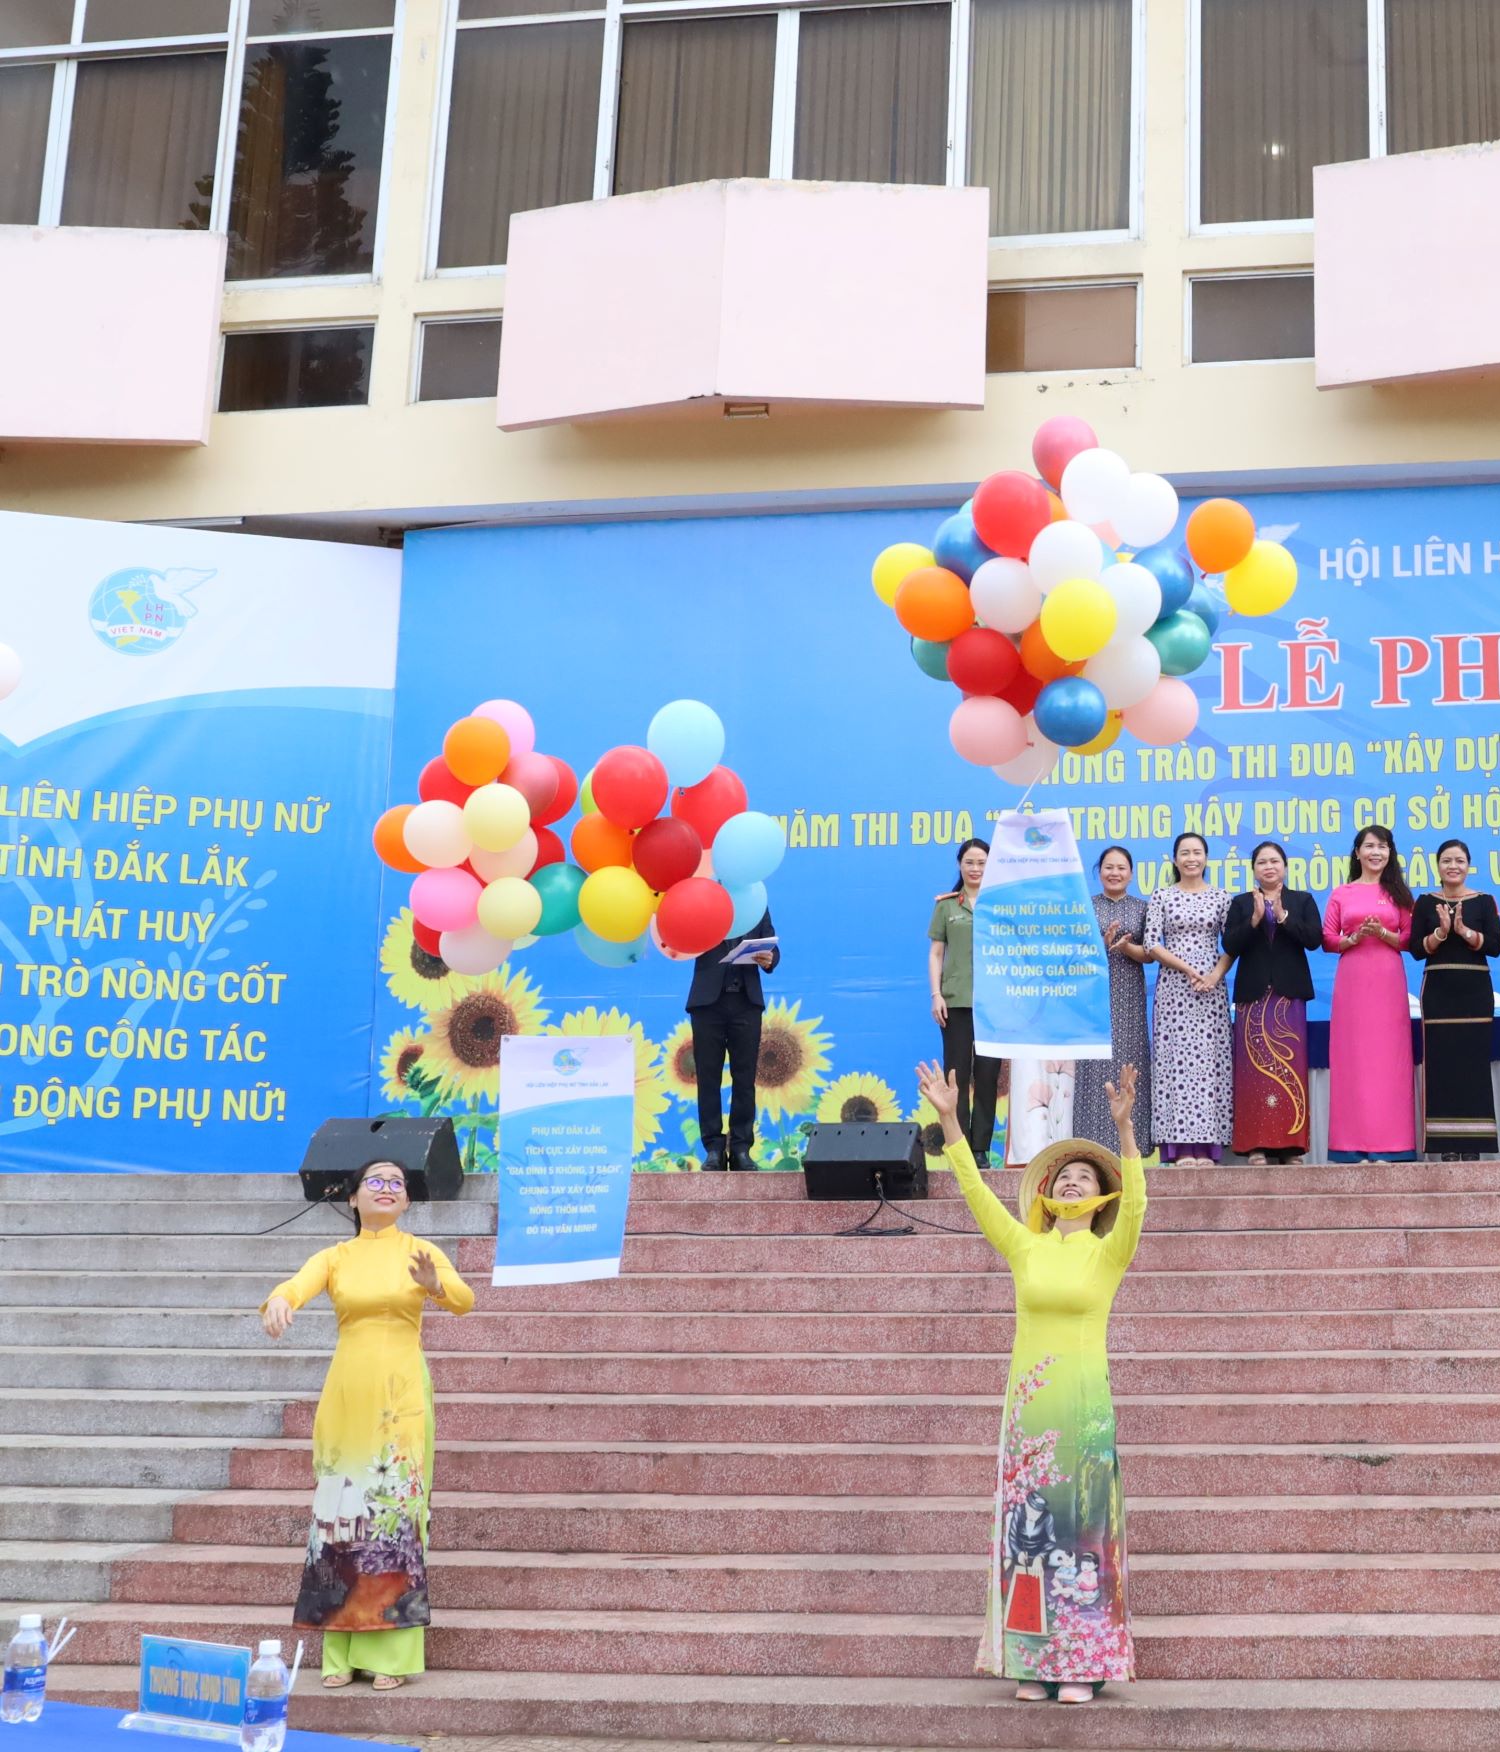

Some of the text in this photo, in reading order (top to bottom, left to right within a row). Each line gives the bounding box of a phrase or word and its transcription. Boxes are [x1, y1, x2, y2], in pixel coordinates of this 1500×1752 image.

[1320, 538, 1380, 587] HỘI
[1393, 535, 1471, 577] LIÊN
[139, 626, 163, 638] NAM
[1212, 617, 1345, 714] LỄ
[1136, 740, 1216, 782] TRÀO
[1227, 744, 1278, 779] THI
[1289, 741, 1355, 777] ĐUA
[1366, 732, 1444, 775] “XÂY
[0, 779, 331, 837] LIÊN HIỆP PHỤ NỮ
[851, 811, 898, 846] THI
[910, 810, 974, 845] ĐUA
[1069, 803, 1172, 841] TRUNG
[1184, 795, 1243, 837] XÂY
[1254, 797, 1342, 840] DỰNG
[1354, 796, 1396, 833] CƠ
[1408, 784, 1450, 830] SỞ
[0, 834, 250, 888] TỈNH ĐẮK LẮK
[1137, 854, 1174, 895] VÀ
[28, 900, 216, 944] PHÁT HUY
[982, 942, 1100, 958] LAO ĐỘNG SÁNG TẠO,
[986, 963, 1096, 979] XÂY DỰNG GIA ĐÌNH
[15, 957, 90, 998] TRÒ
[100, 960, 207, 1003] NÒNG
[217, 961, 288, 1004] CỐT
[1006, 983, 1077, 999] HẠNH PHÚC!
[85, 1018, 189, 1060] CÔNG
[199, 1023, 267, 1063] TÁC
[12, 1076, 287, 1128] ĐỘNG PHỤ NỮ!
